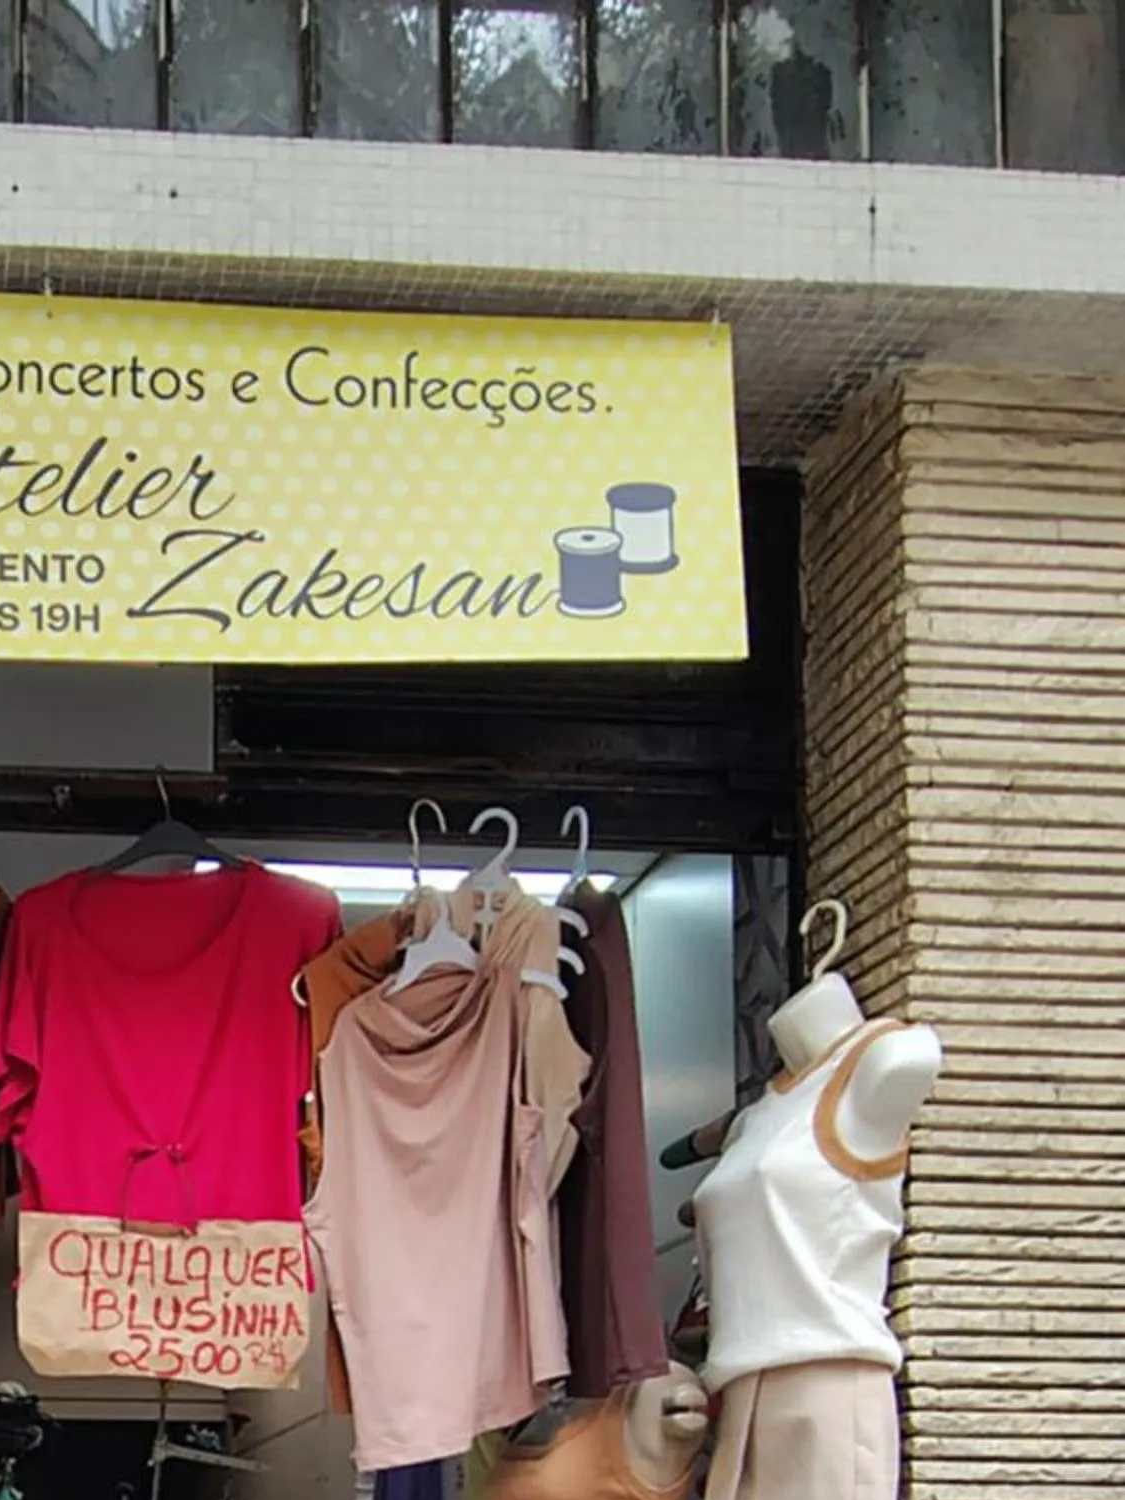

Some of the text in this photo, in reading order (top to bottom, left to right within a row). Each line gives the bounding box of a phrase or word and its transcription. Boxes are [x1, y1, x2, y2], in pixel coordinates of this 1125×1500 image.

[231, 370, 259, 404] e
[285, 347, 614, 428] Confecções.
[32, 604, 100, 633] 19H
[126, 529, 561, 633] Zakesan
[50, 1230, 304, 1311] QUALQUER
